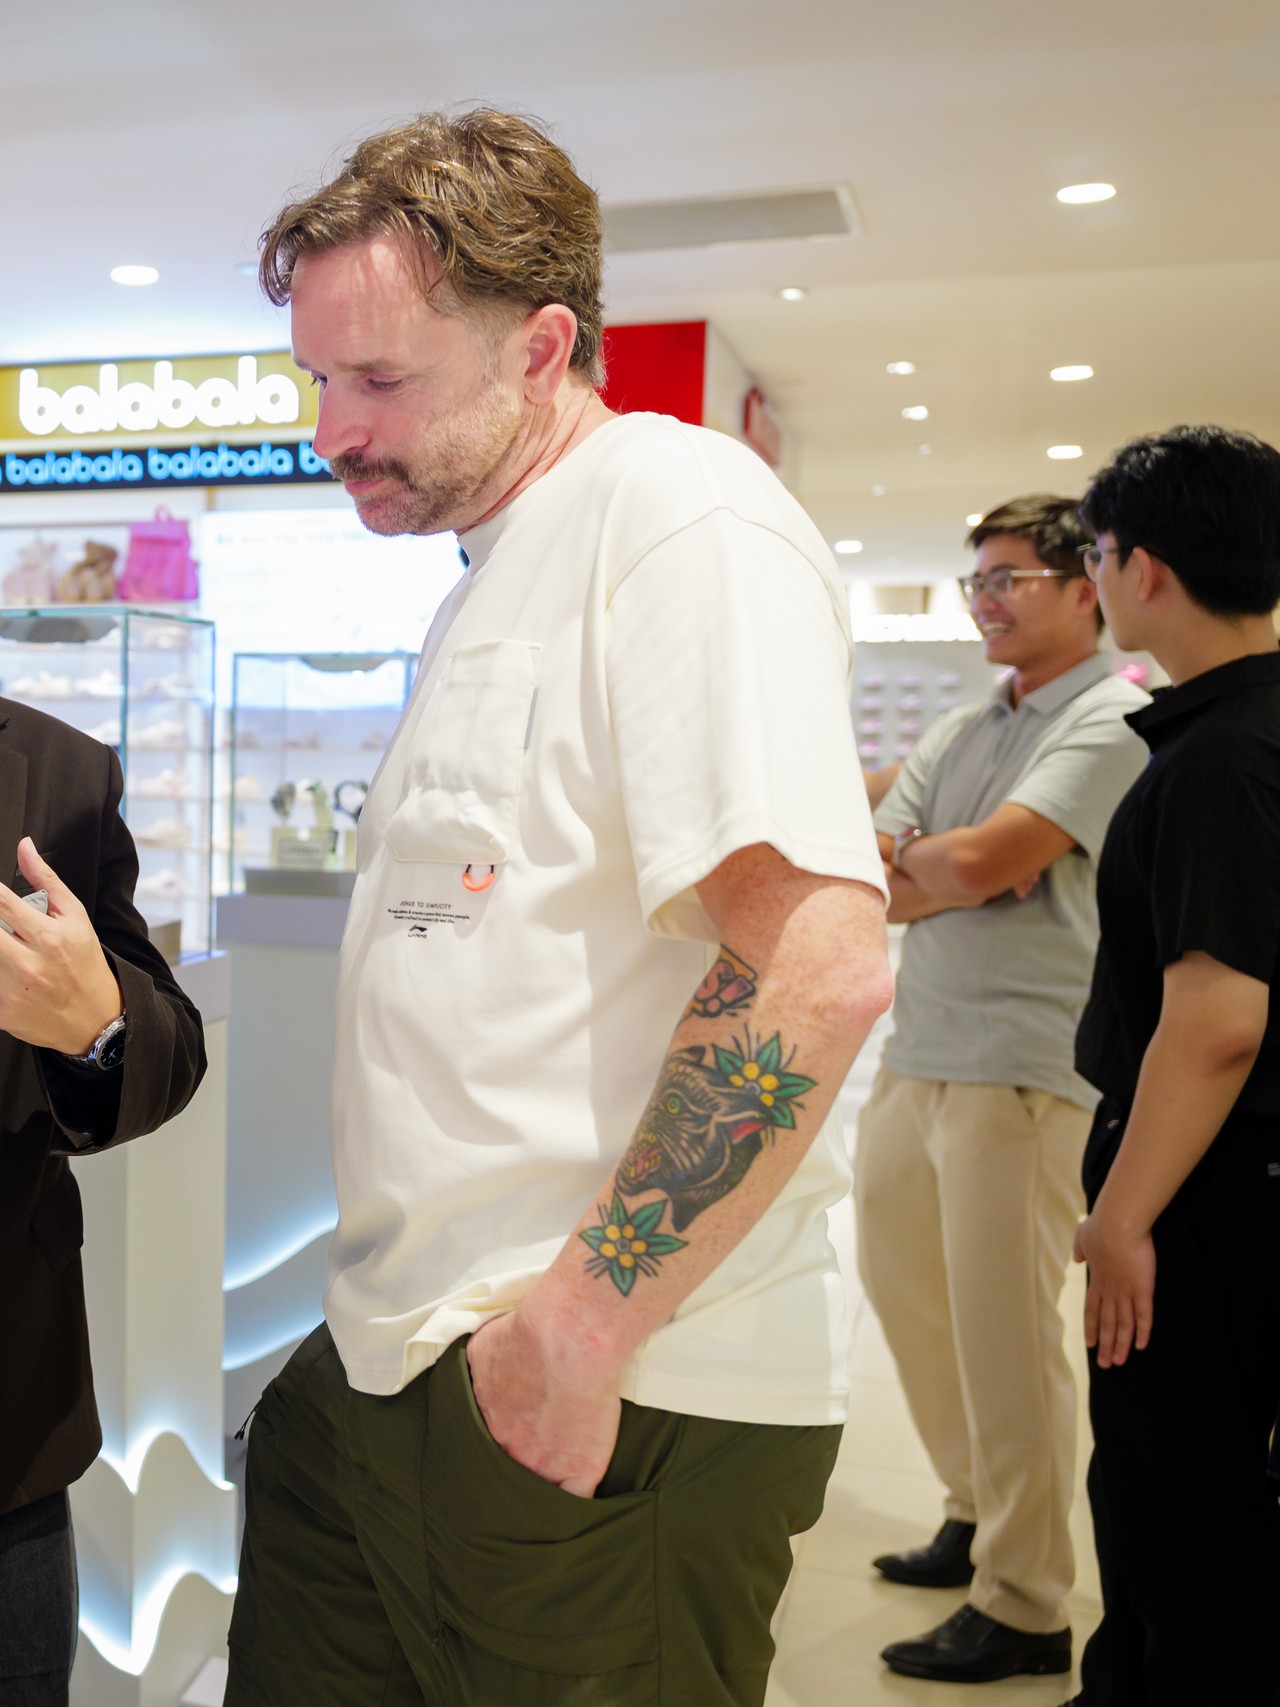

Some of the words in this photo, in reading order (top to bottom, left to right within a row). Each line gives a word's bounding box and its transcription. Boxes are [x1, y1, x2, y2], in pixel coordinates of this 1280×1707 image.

[20, 355, 299, 435] balabala
[5, 447, 144, 486] balabala
[148, 442, 294, 480] balabala
